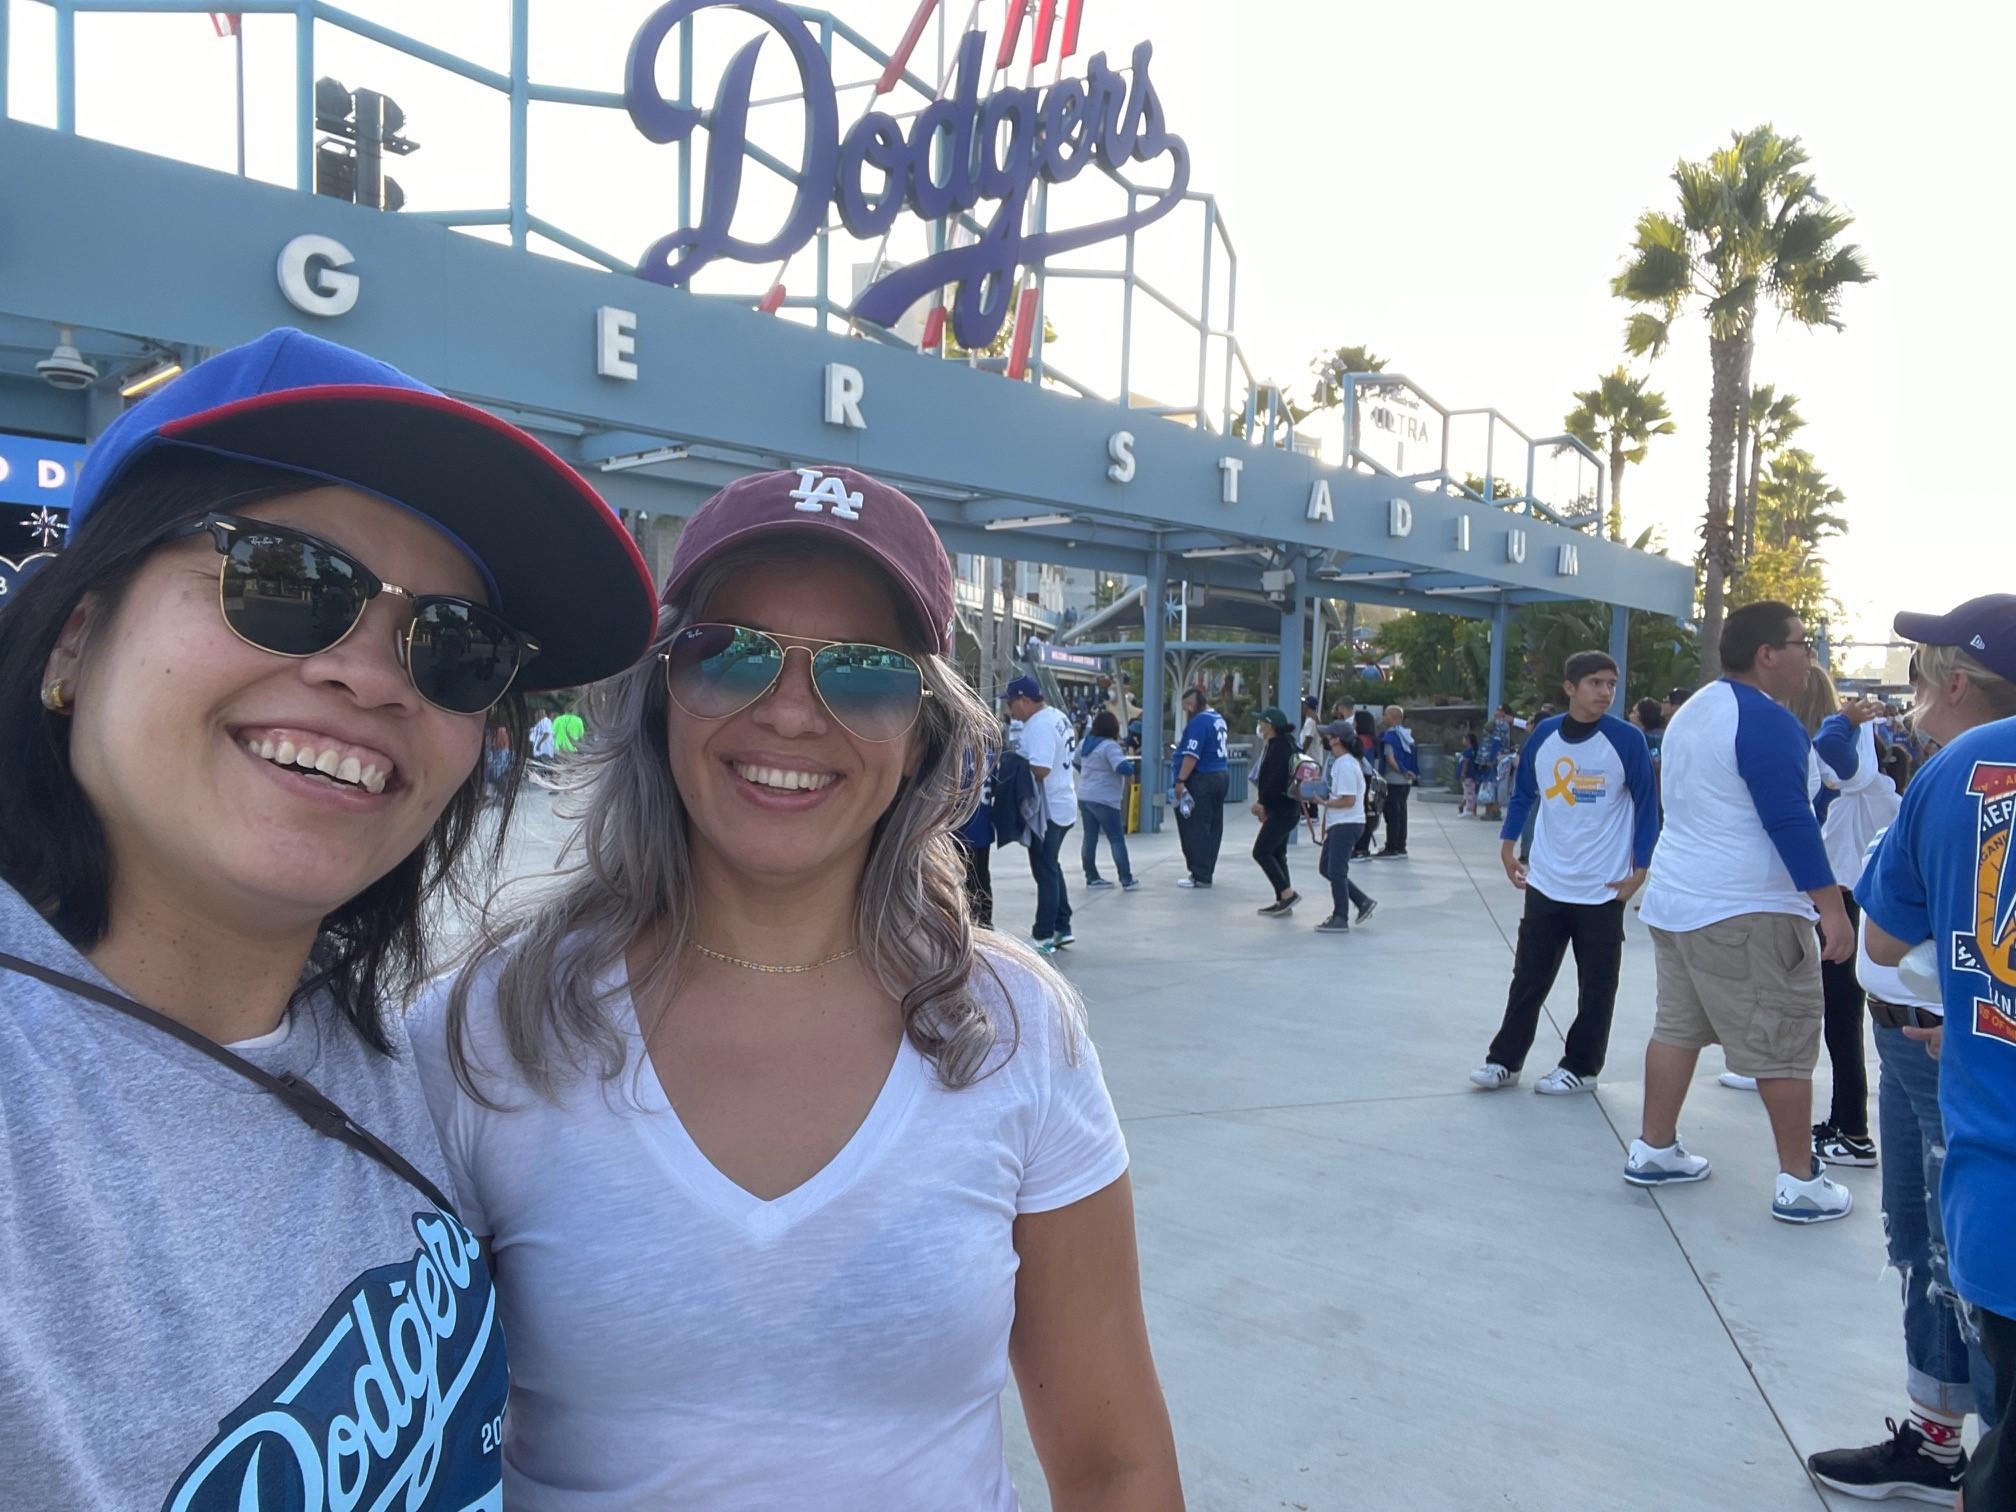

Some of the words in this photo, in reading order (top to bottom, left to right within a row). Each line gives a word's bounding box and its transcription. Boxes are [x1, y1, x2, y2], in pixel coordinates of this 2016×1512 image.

[625, 0, 1190, 348] Dodgers
[788, 468, 864, 521] LA
[1107, 430, 1579, 577] STADIUM
[168, 1208, 496, 1512] Dodgers
